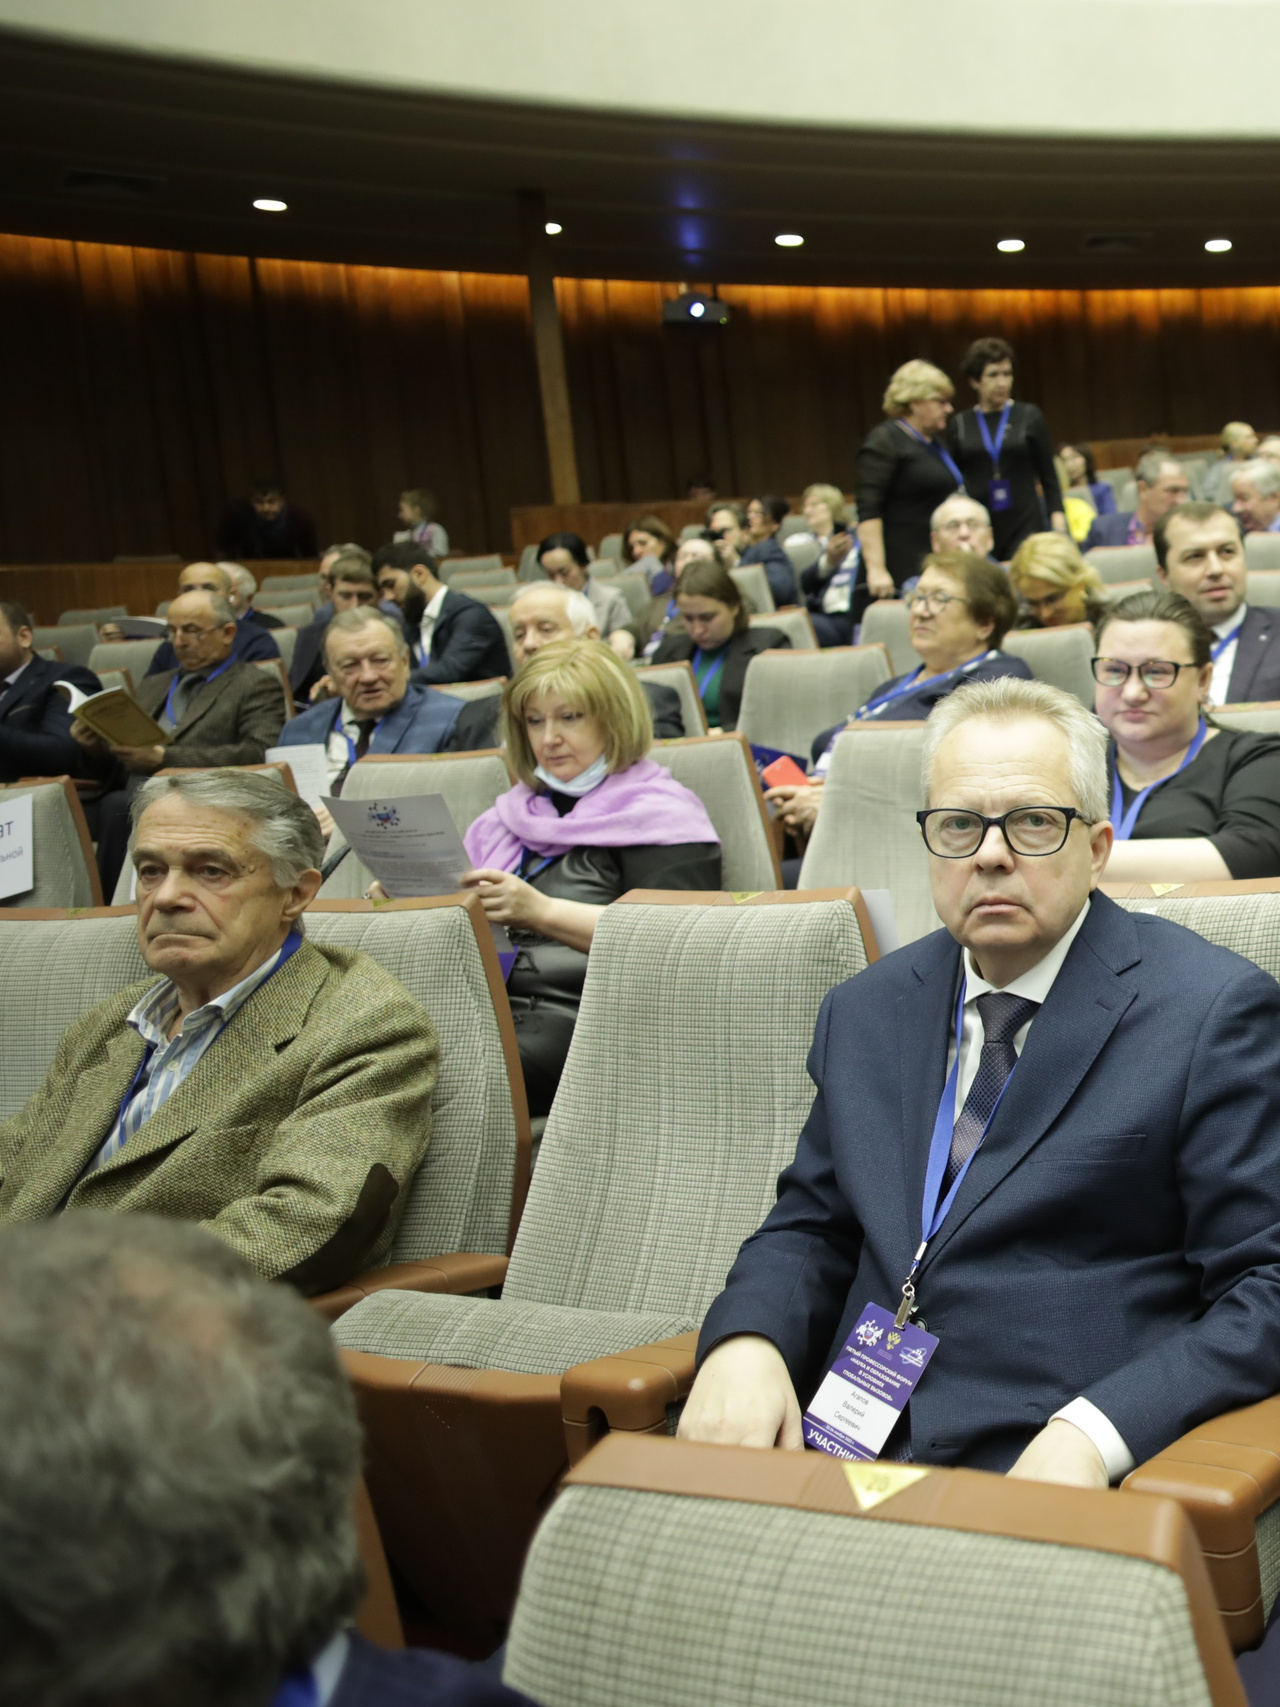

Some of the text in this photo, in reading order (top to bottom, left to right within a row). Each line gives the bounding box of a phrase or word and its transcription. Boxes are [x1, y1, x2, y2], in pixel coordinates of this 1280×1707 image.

[861, 1353, 898, 1377] ПРОФЕССОРСКИЙ
[870, 1367, 901, 1389] ОБРАЗОВАНИЕ
[850, 1390, 869, 1405] Агапов
[842, 1400, 866, 1417] Валерий
[834, 1410, 861, 1430] Сергеевич
